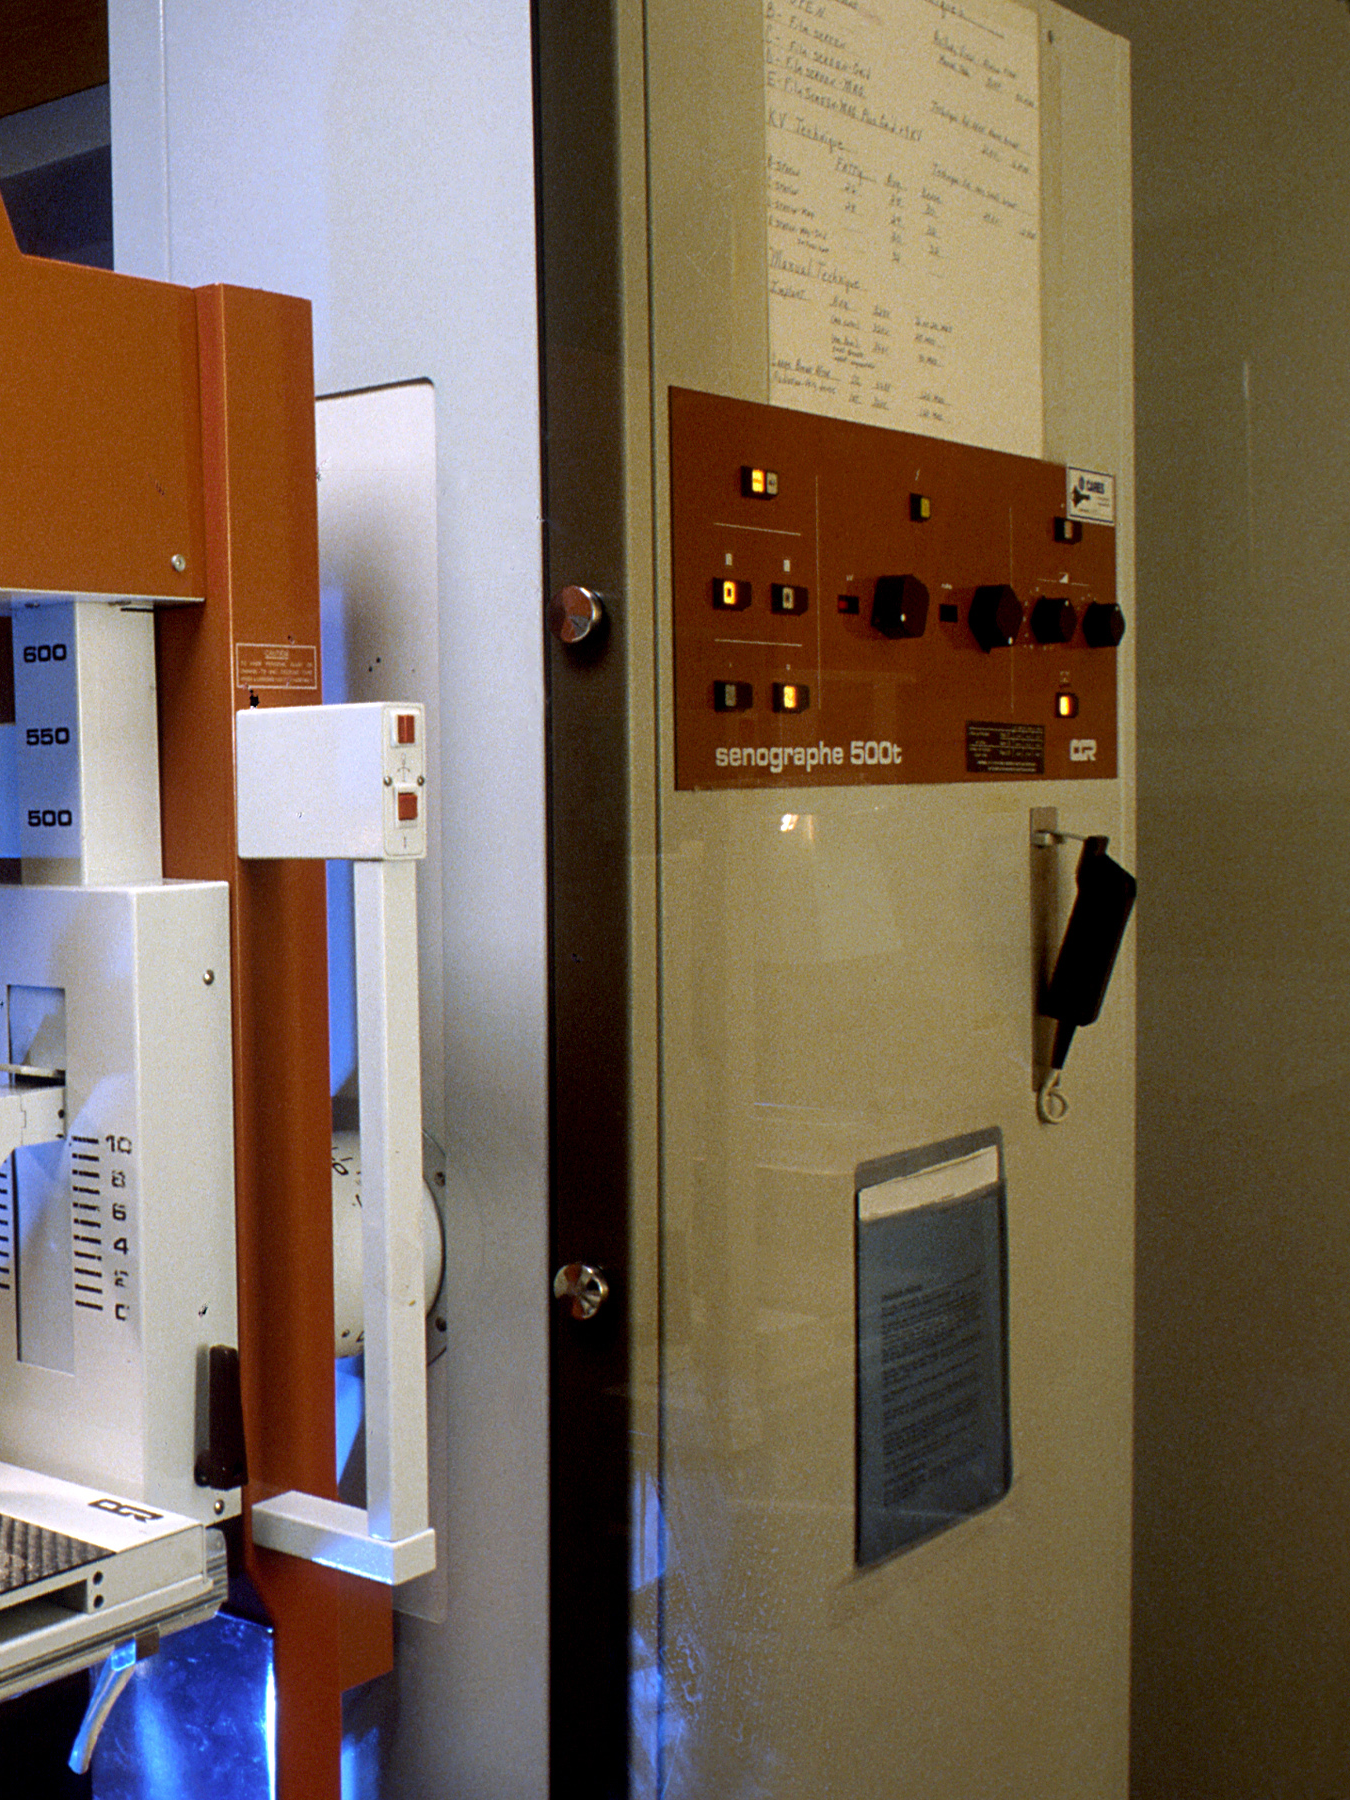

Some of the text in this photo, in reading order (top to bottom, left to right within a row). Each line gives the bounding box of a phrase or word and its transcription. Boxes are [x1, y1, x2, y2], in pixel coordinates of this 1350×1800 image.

[23, 644, 67, 663] 600
[26, 727, 70, 746] 550
[715, 741, 902, 773] senographe 500t
[28, 810, 72, 827] 500
[105, 1135, 132, 1155] 10
[112, 1202, 126, 1221] 6
[113, 1237, 129, 1255] 4
